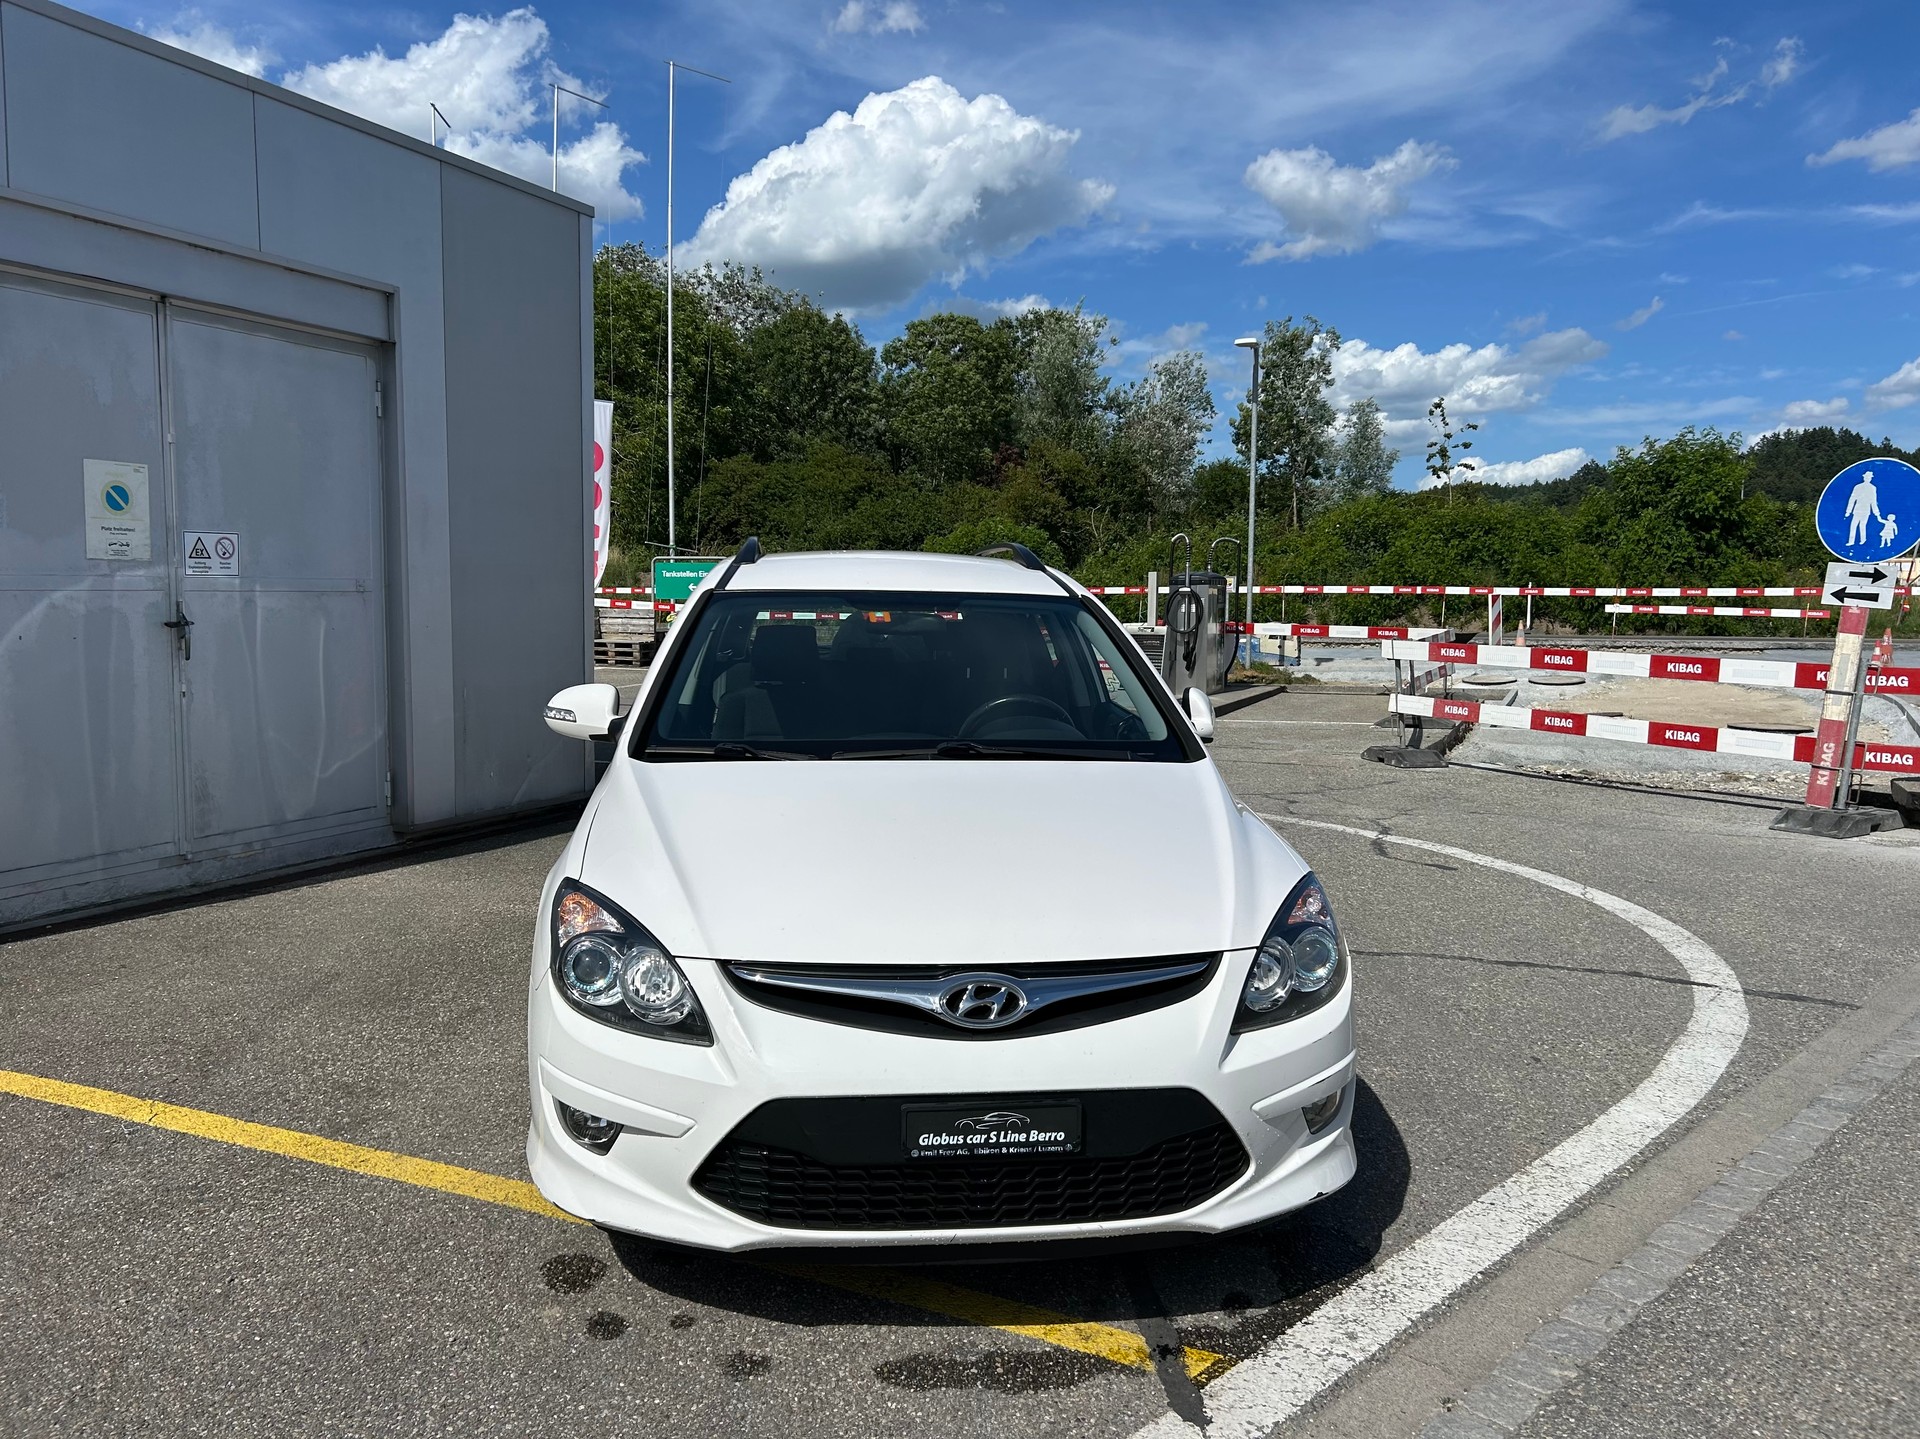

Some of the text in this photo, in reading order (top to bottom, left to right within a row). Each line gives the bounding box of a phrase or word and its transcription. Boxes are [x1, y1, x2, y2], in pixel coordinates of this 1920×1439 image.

[661, 570, 698, 578] Tankstellen
[1440, 647, 1466, 658] KIBAG
[1544, 654, 1574, 665] KIBAG
[1667, 662, 1702, 674] KIBAG
[1444, 705, 1469, 716] KIBAG
[1544, 716, 1573, 728] KIBAG
[1665, 730, 1700, 742] KIBAG
[1865, 752, 1914, 765] KIBAG
[919, 1130, 1065, 1146] Globus car S Line Berro
[1001, 1146, 1008, 1154] &
